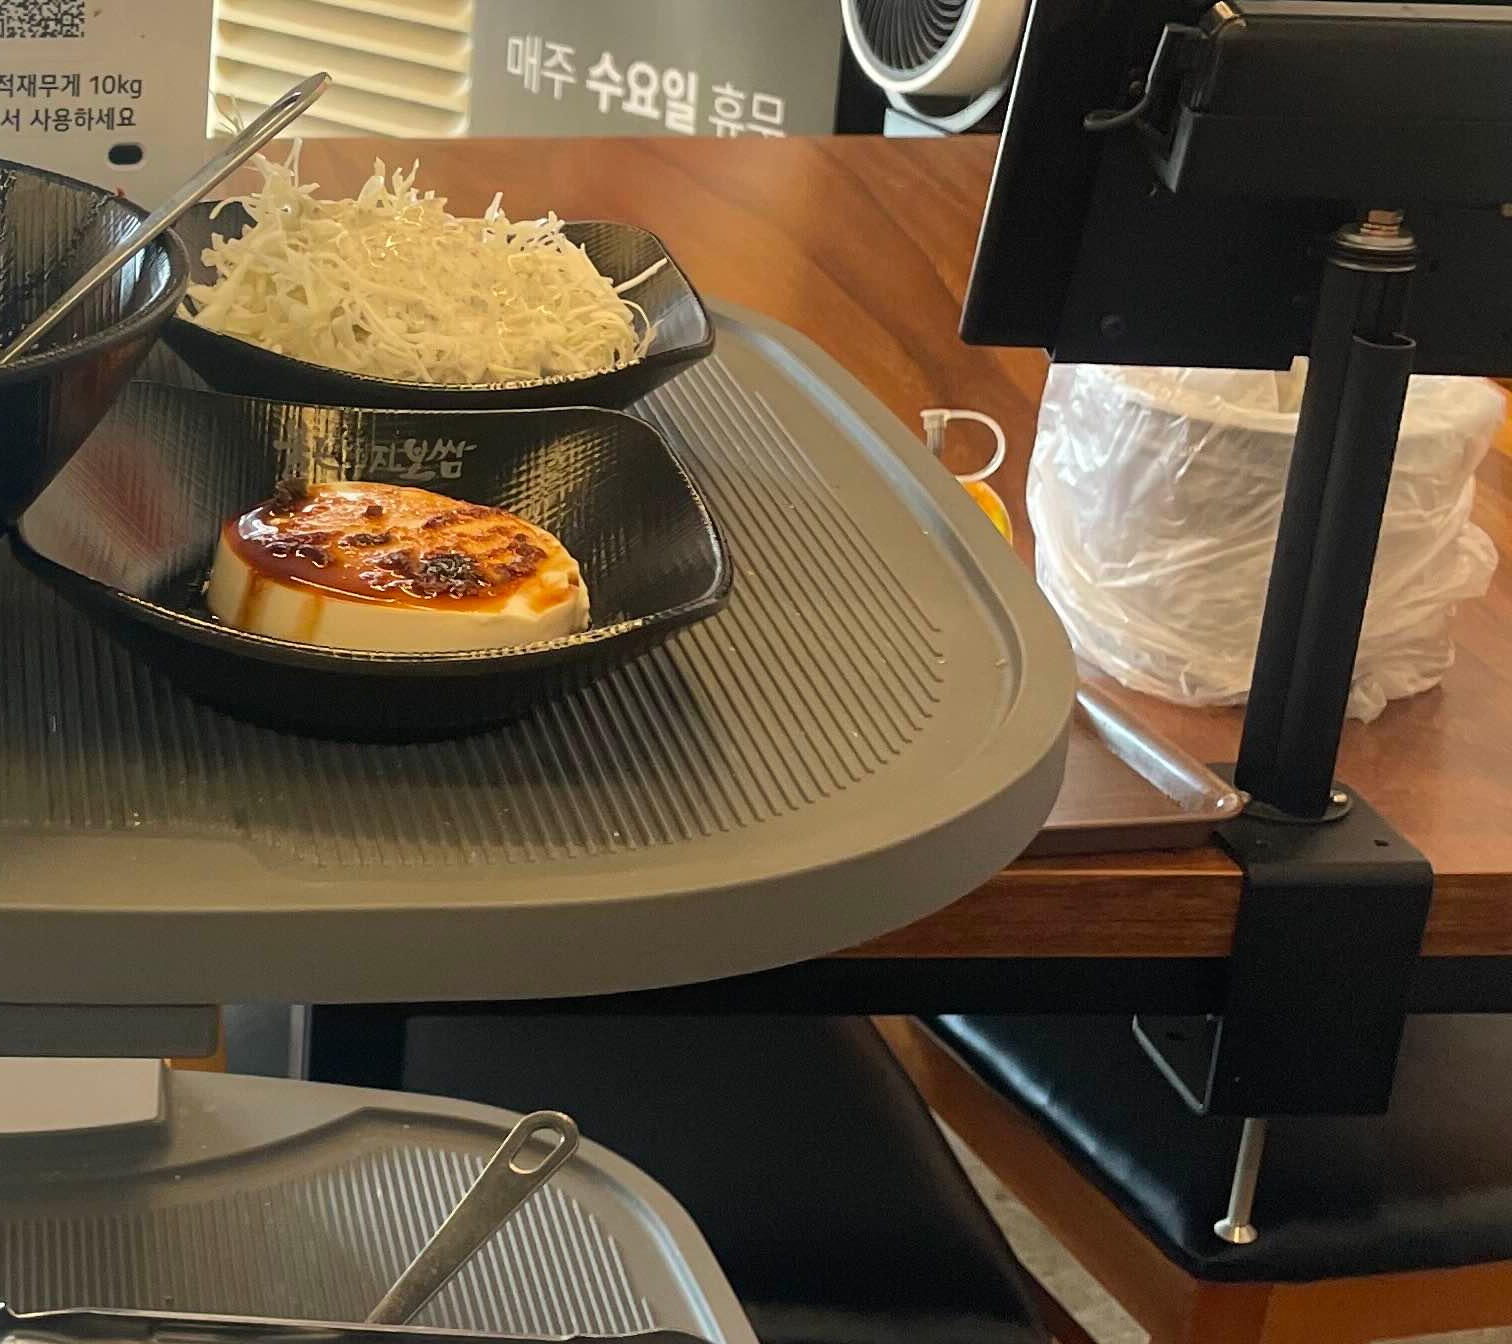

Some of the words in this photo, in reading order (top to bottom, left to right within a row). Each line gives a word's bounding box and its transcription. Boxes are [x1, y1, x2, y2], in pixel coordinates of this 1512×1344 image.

[88, 75, 144, 99] 10kg
[506, 34, 578, 101] 매주
[585, 51, 699, 136] 수요일
[707, 80, 788, 138] 휴무
[29, 108, 137, 132] 사용하세요
